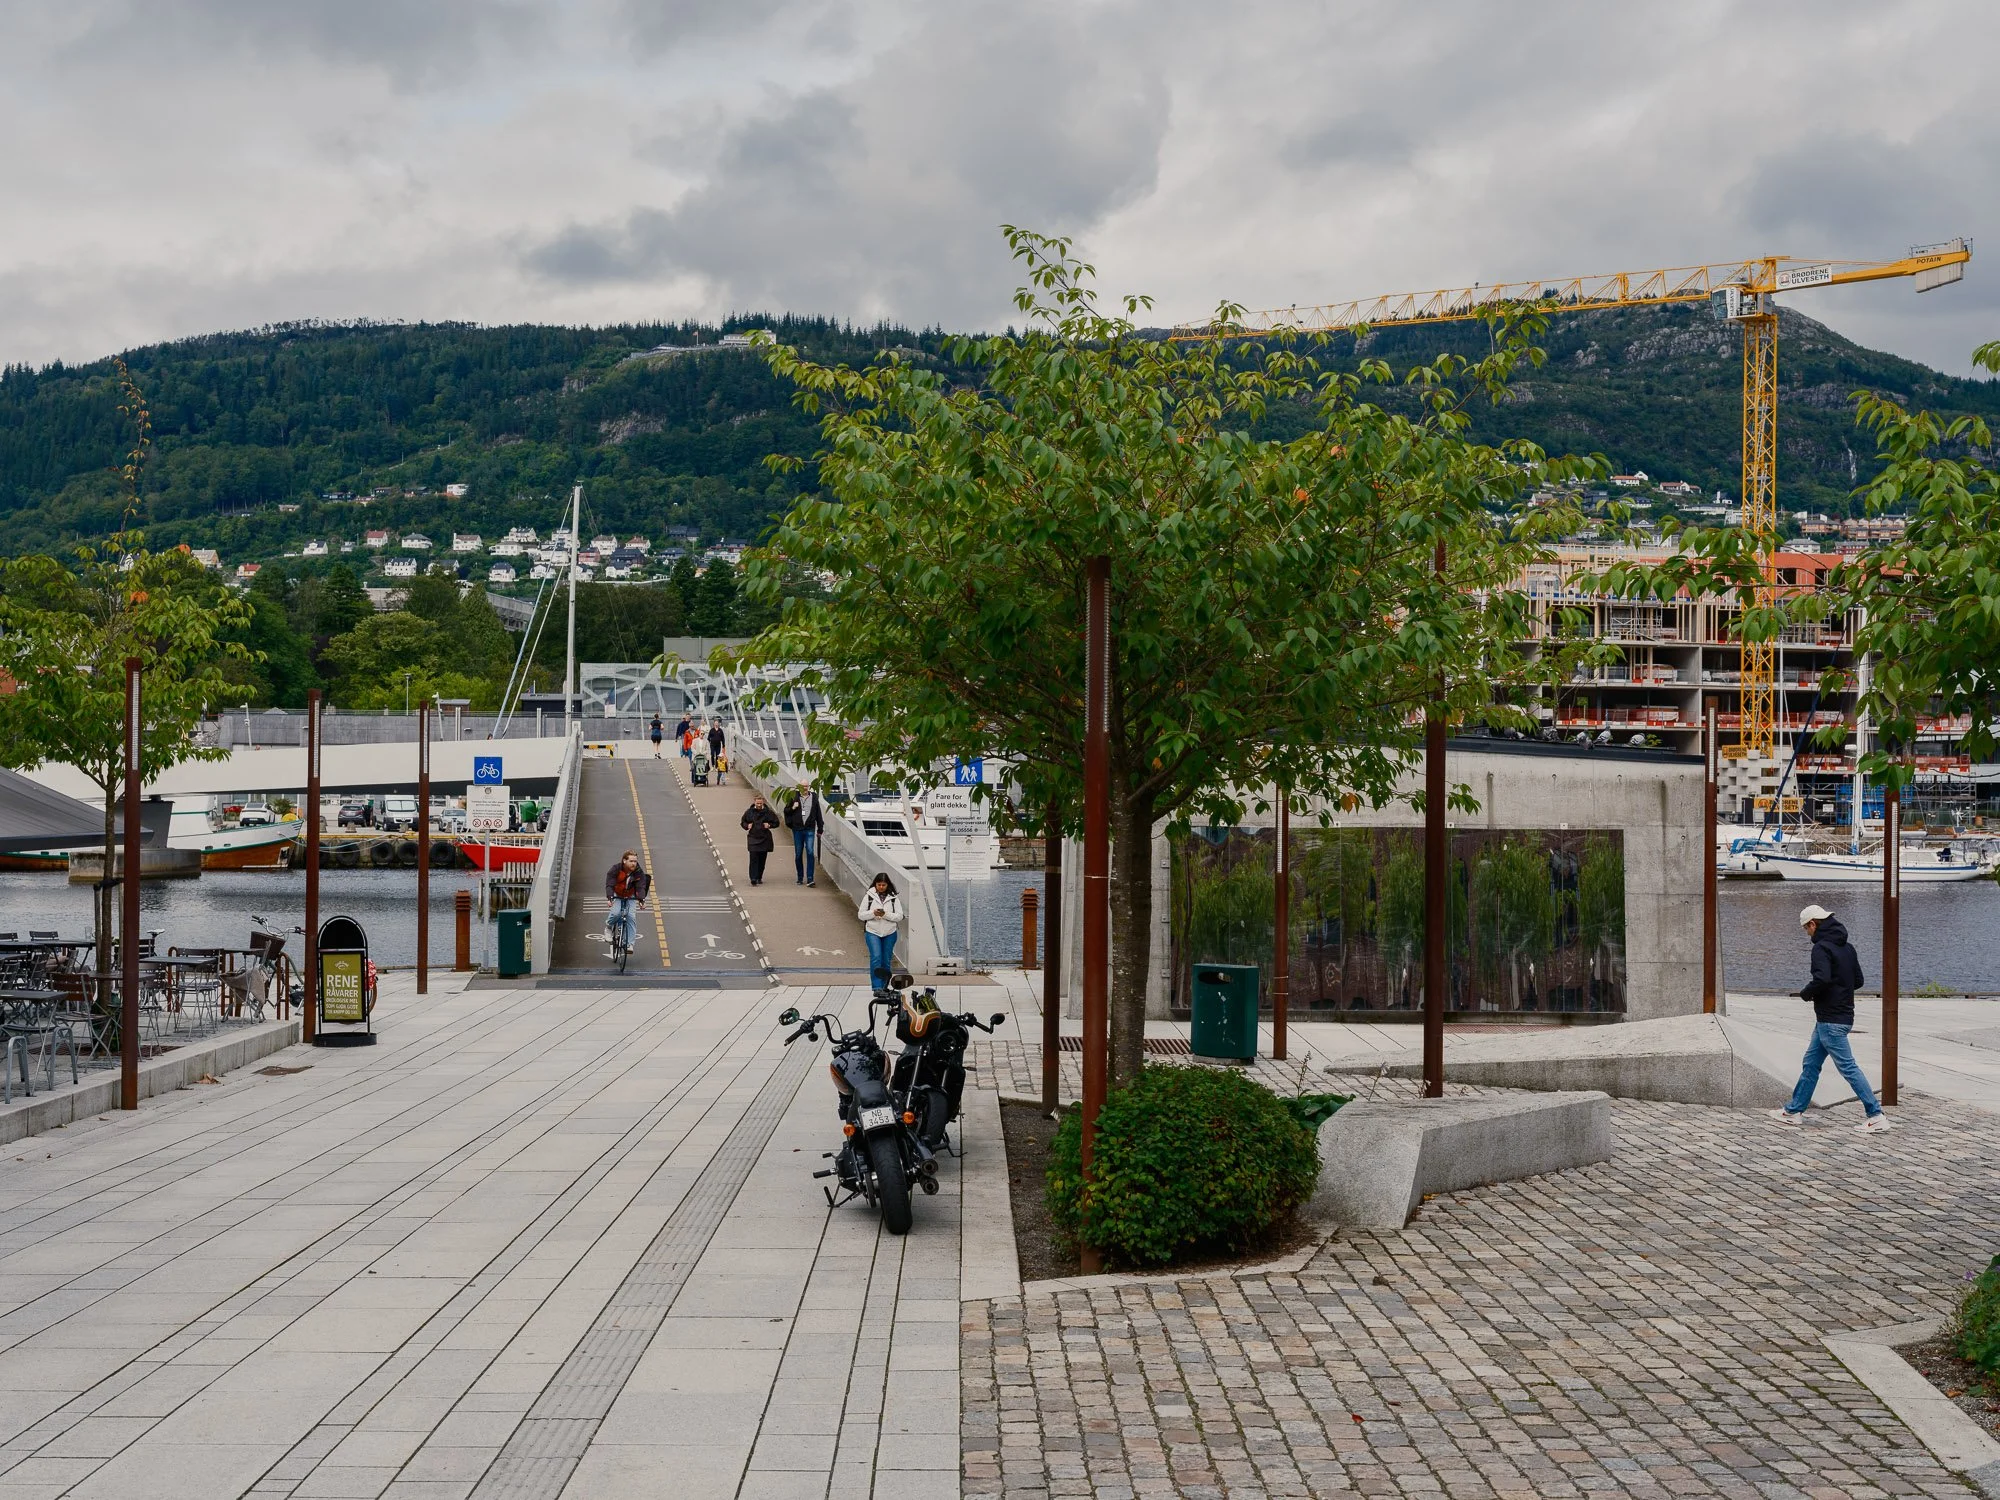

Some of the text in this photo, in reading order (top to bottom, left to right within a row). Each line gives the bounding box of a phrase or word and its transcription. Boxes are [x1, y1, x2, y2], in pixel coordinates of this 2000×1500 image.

[1916, 256, 1942, 264] POTAIN
[1791, 268, 1829, 279] BRØDRENE
[1791, 274, 1829, 284] ULVESETH
[326, 974, 359, 988] RENE
[326, 986, 359, 998] RÅVARER
[871, 1109, 883, 1117] NB
[869, 1116, 890, 1126] 3453
